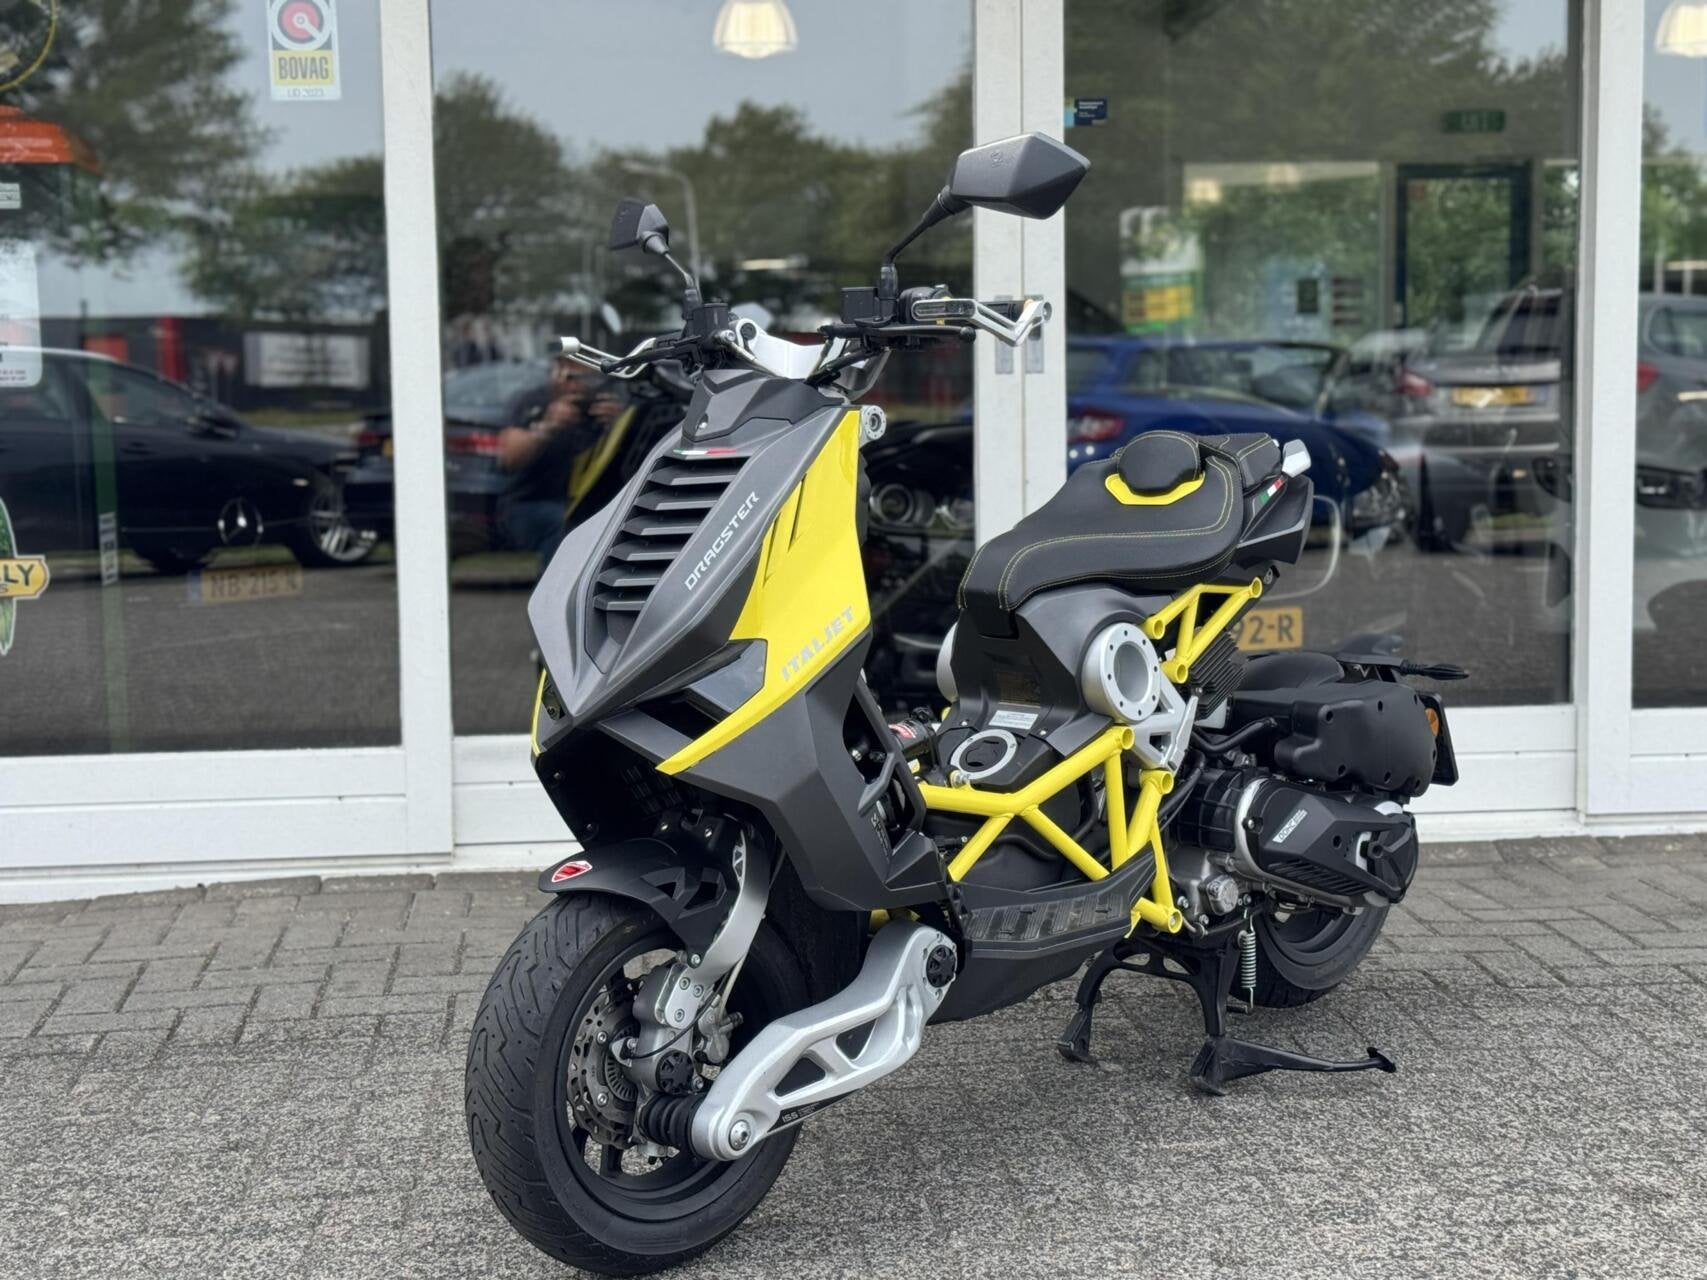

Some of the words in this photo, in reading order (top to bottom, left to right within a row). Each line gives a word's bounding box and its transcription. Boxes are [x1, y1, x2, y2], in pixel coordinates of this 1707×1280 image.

[278, 56, 330, 80] BOVAG
[684, 490, 760, 591] DRAGSTER
[780, 605, 855, 682] ITALJET
